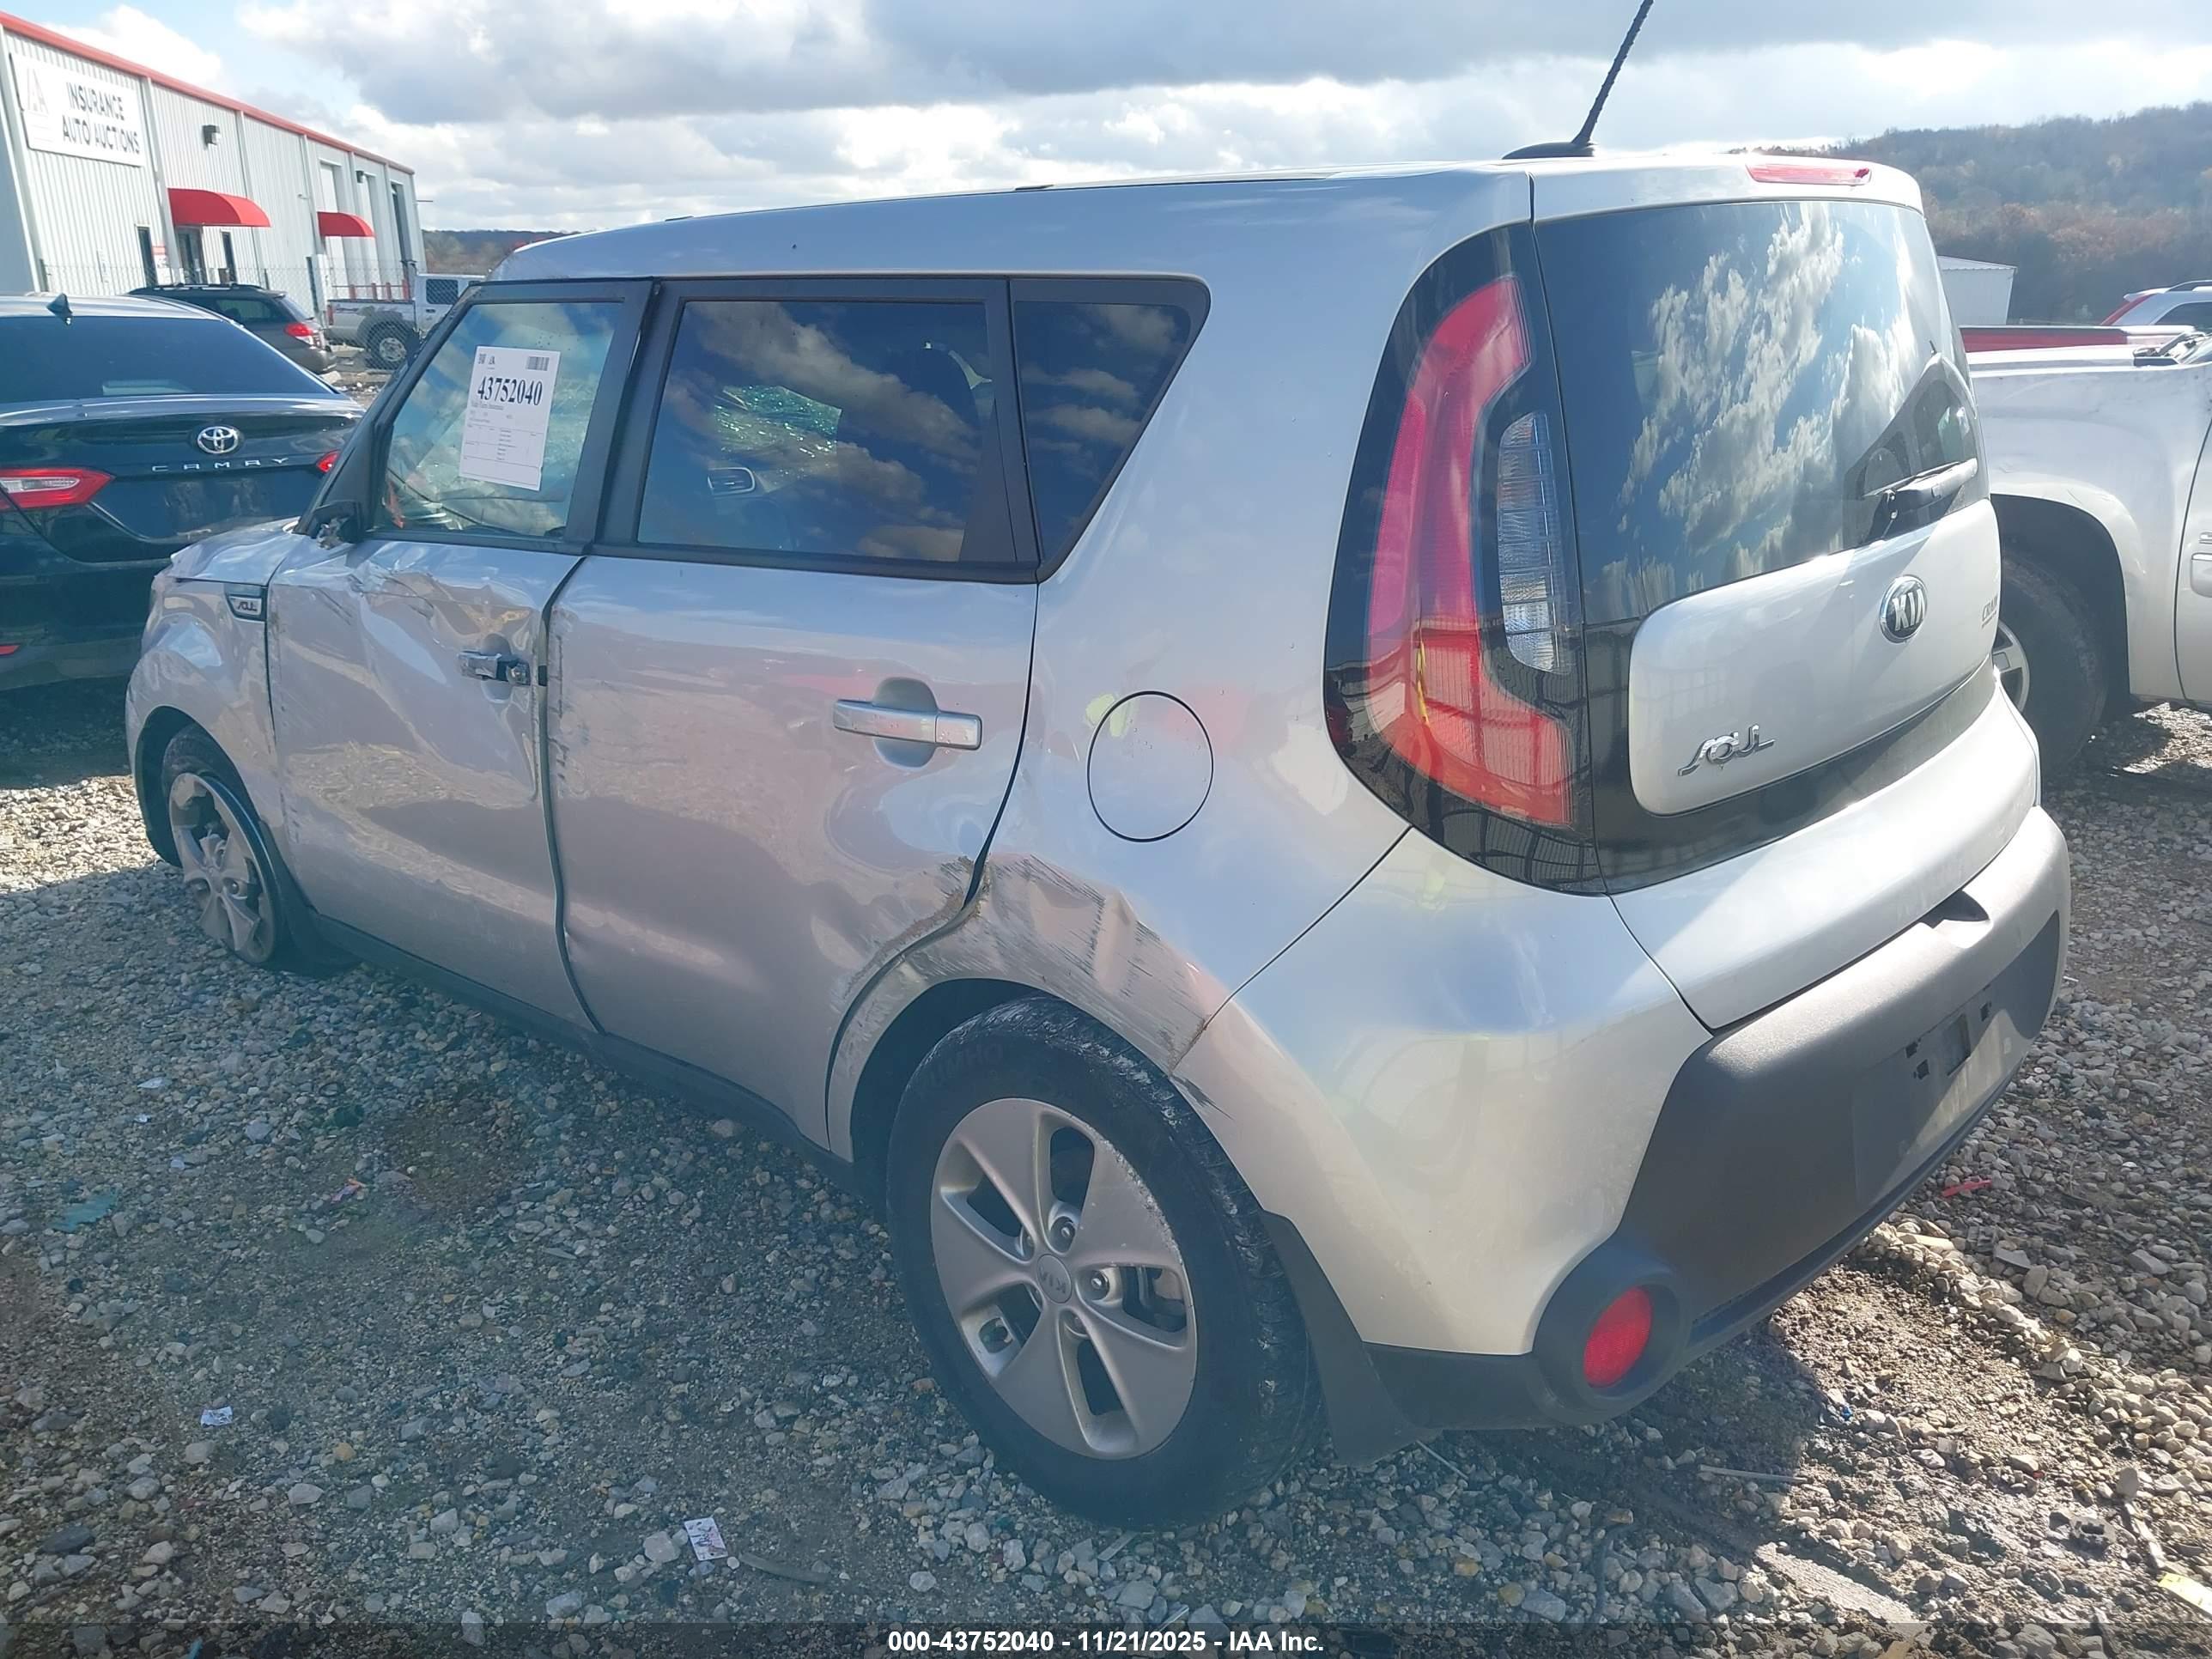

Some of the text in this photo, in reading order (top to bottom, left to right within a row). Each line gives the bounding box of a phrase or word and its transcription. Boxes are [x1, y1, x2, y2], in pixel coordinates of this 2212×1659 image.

[65, 82, 125, 121] INSURANCE
[62, 114, 140, 155] AUTO AUCTIONS
[477, 375, 543, 406] 43752040
[152, 457, 289, 472] CAMRY
[1892, 588, 1925, 631] KIA
